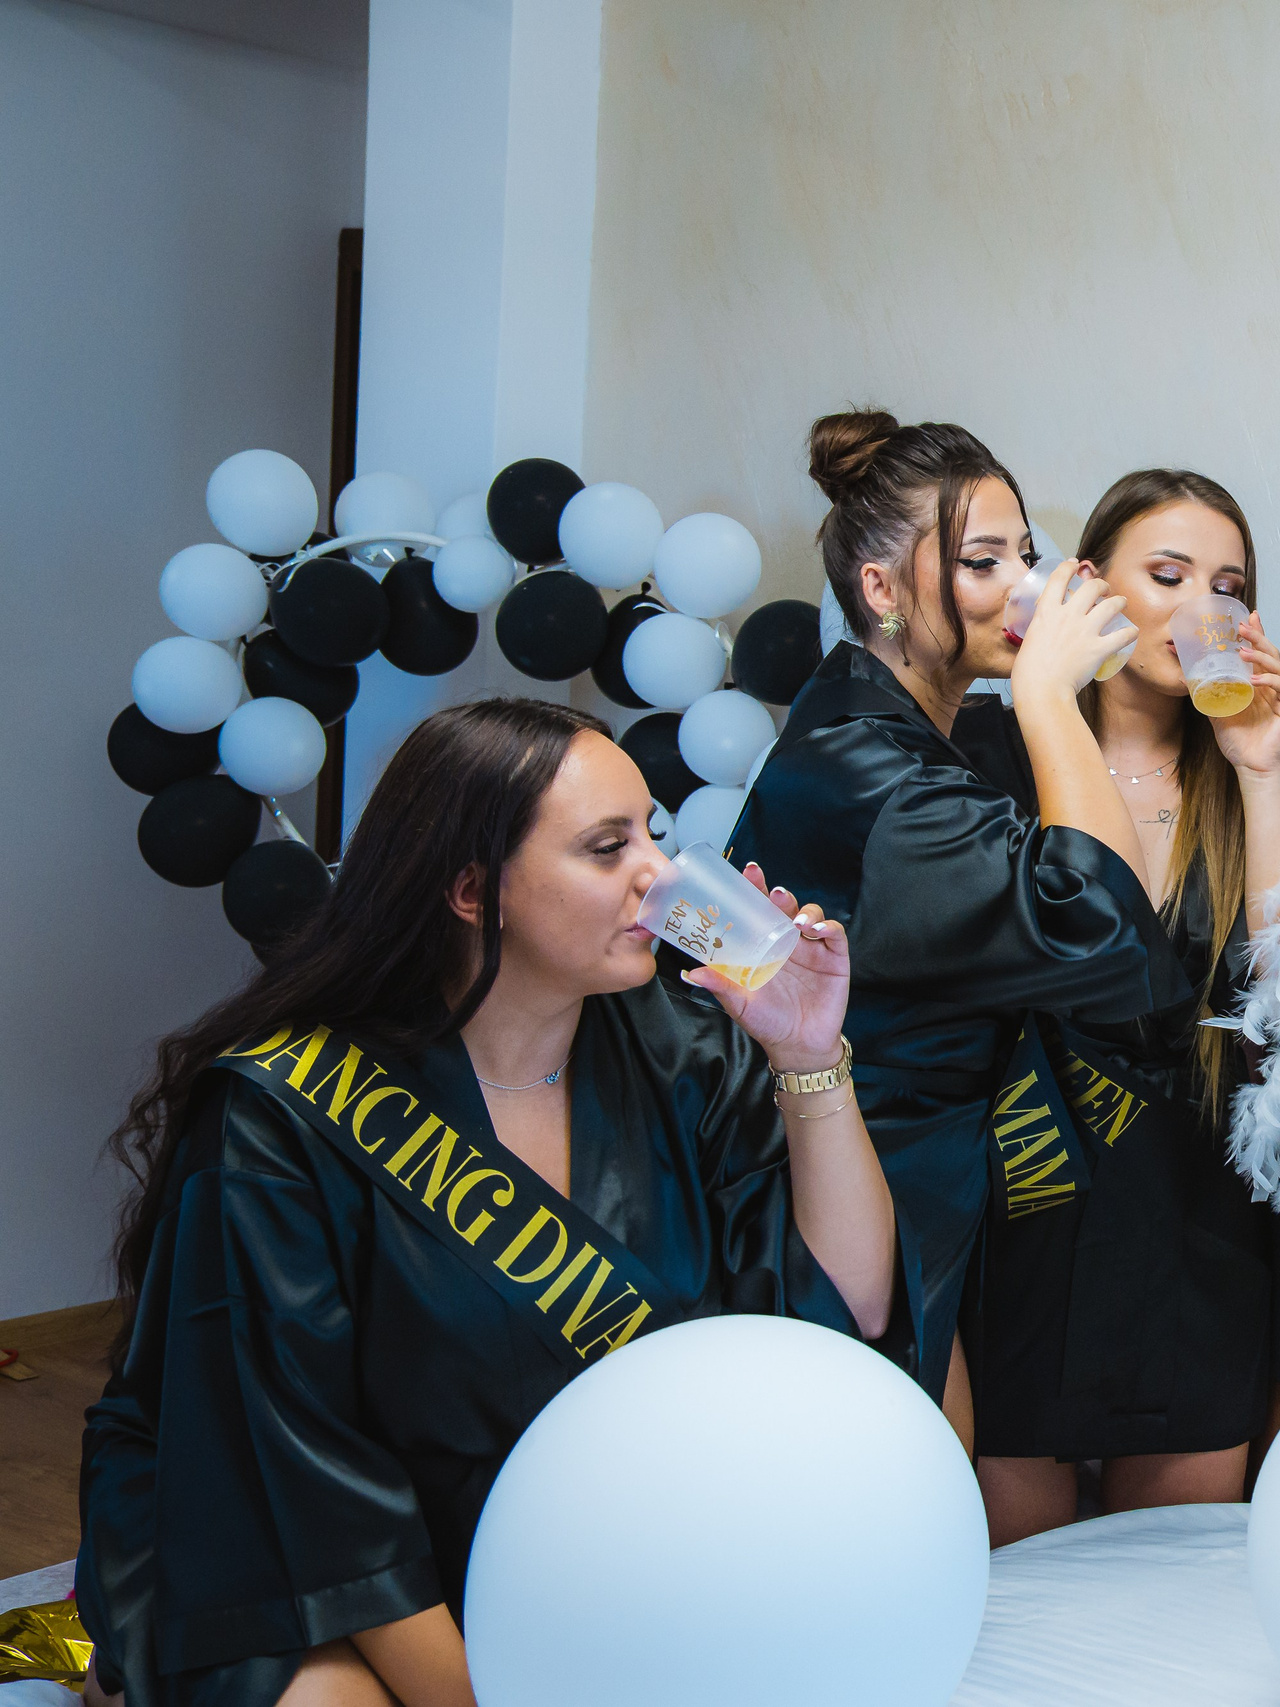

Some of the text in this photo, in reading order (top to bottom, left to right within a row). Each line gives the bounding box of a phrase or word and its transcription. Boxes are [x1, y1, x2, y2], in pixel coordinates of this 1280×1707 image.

[1195, 625, 1243, 646] Bride
[1200, 613, 1233, 625] TEAM
[665, 899, 692, 934] TEAM
[678, 905, 719, 954] Bride
[993, 1070, 1075, 1220] MAMA
[493, 1205, 653, 1359] DIVA
